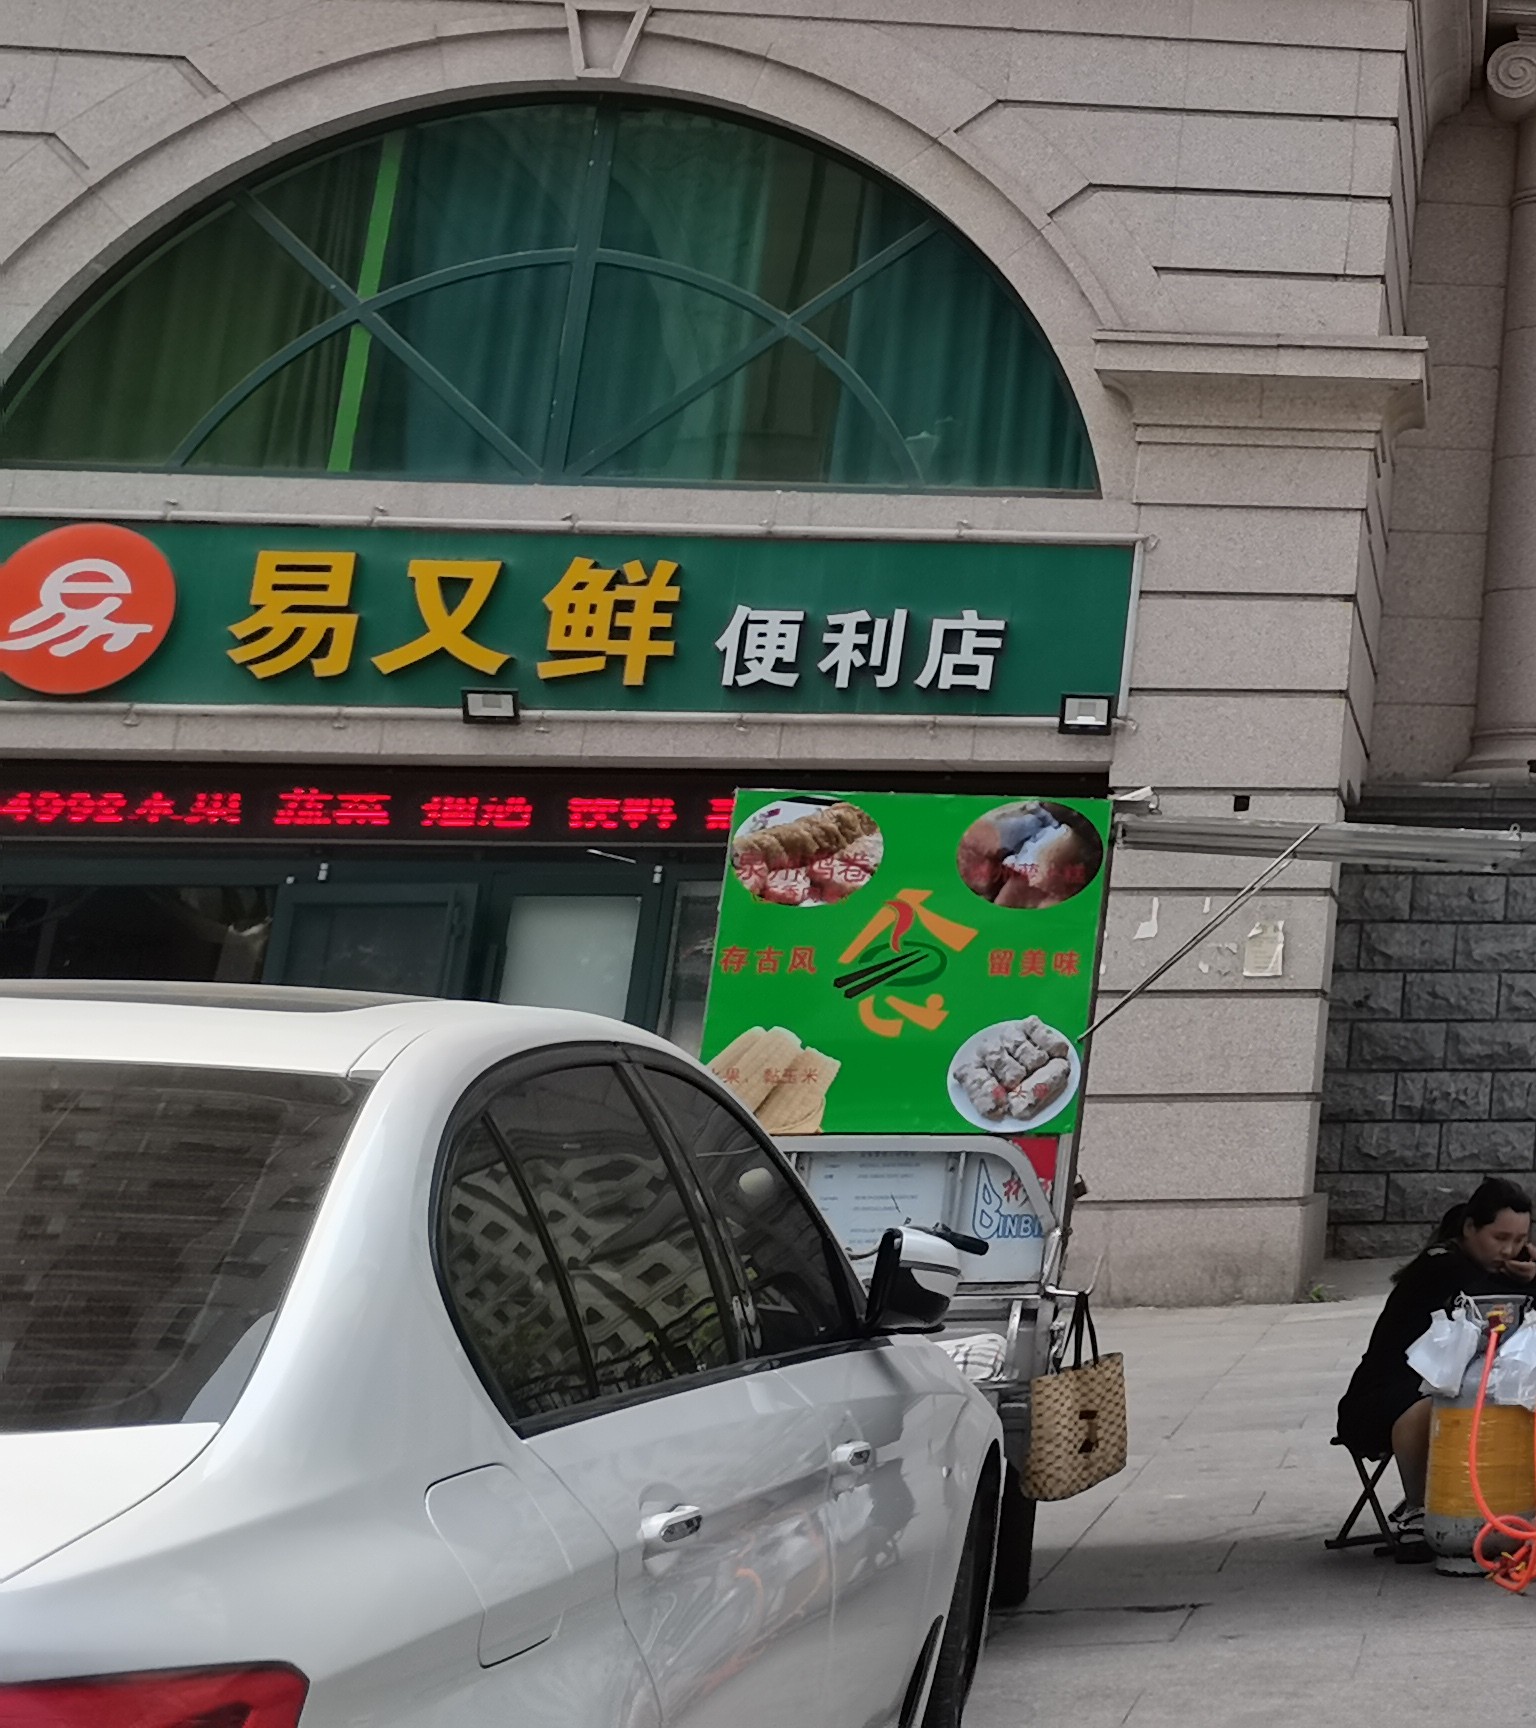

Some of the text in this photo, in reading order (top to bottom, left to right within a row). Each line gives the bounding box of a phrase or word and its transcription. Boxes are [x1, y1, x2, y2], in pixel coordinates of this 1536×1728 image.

[228, 550, 681, 686] 易又鲜
[715, 604, 1007, 691] 便利店
[719, 945, 818, 974] 存古风
[990, 949, 1080, 976] 留美味
